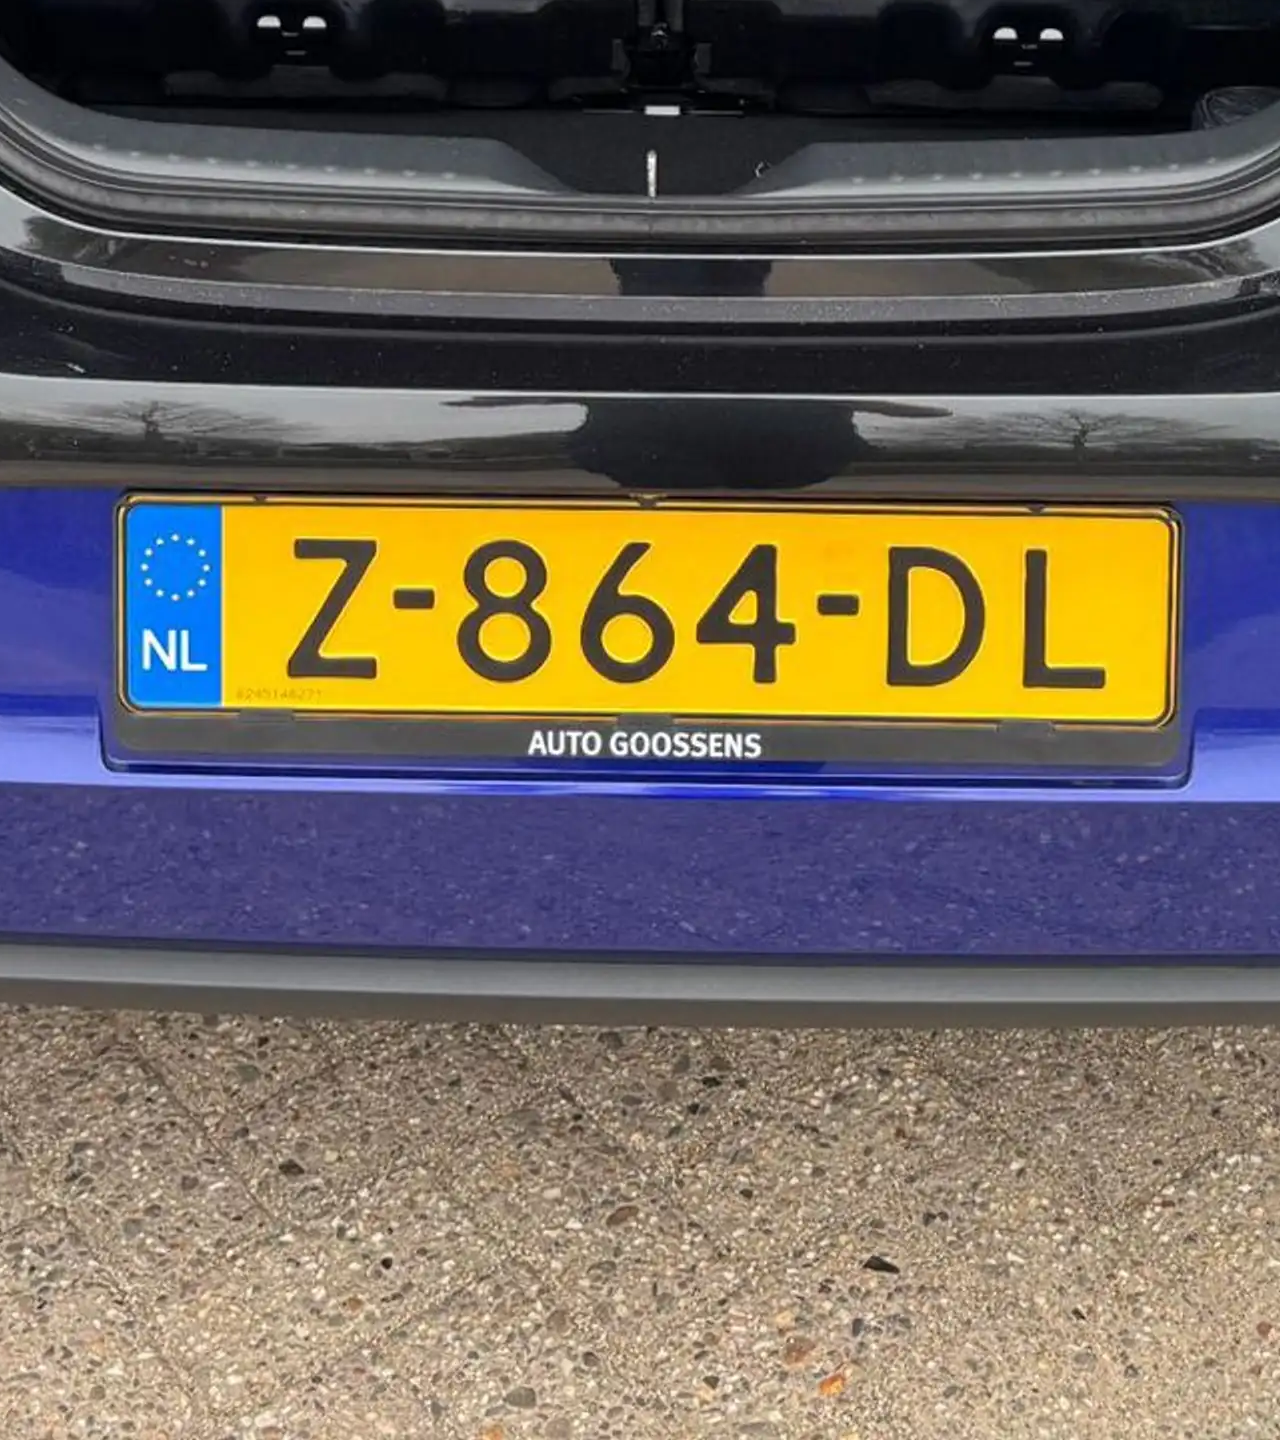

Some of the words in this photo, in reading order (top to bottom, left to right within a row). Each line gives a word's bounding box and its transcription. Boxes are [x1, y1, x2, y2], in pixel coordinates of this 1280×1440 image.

[286, 538, 1106, 689] Z-864-DL
[141, 628, 208, 672] NL
[527, 730, 602, 756] AUTO
[609, 731, 762, 759] GOOSSENS
